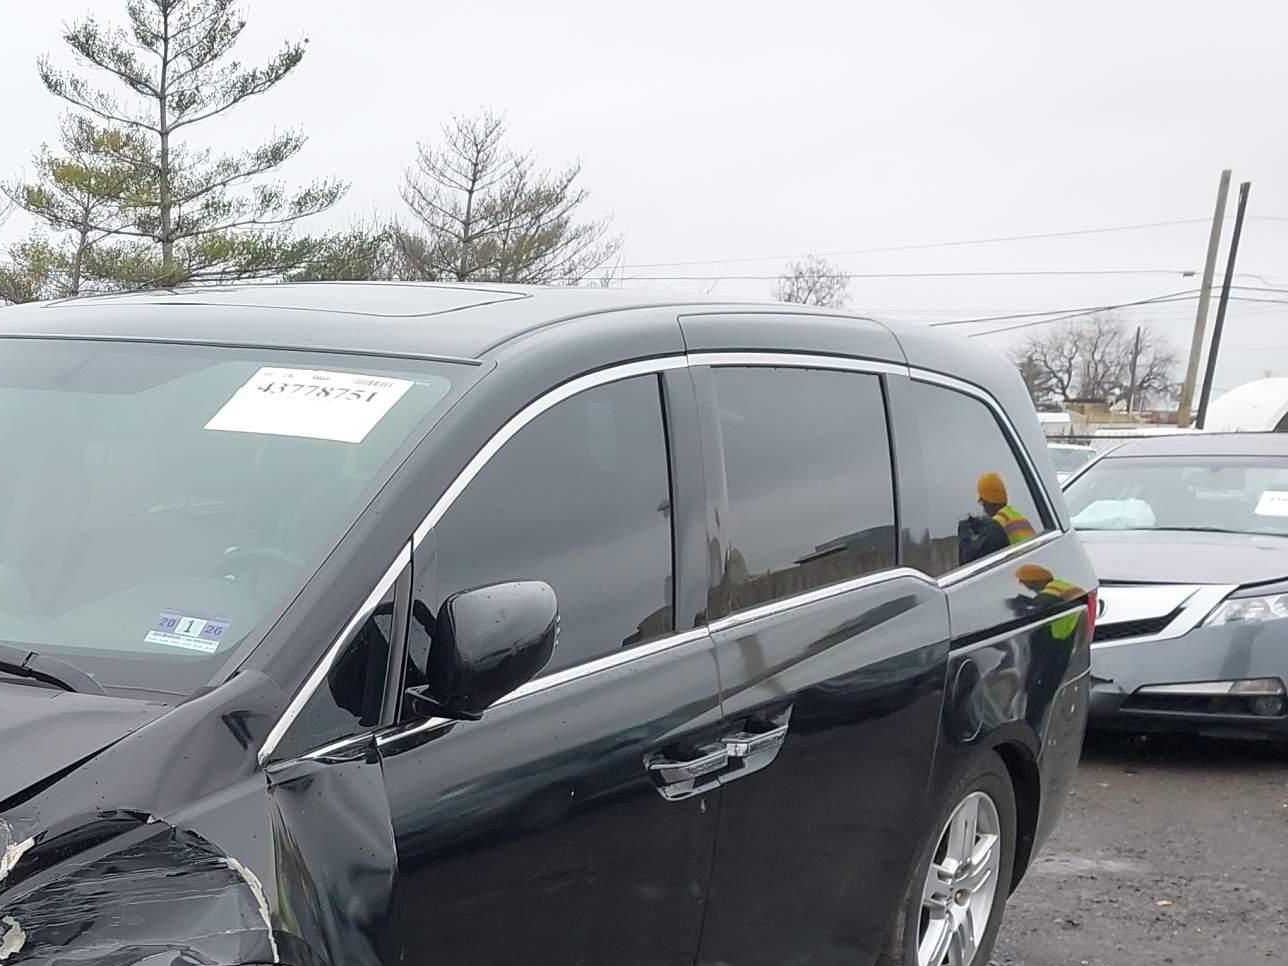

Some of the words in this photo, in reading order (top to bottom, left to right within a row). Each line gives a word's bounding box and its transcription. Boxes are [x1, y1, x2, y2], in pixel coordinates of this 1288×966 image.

[257, 380, 379, 403] 43778751
[159, 617, 176, 629] 20
[204, 624, 224, 636] 26
